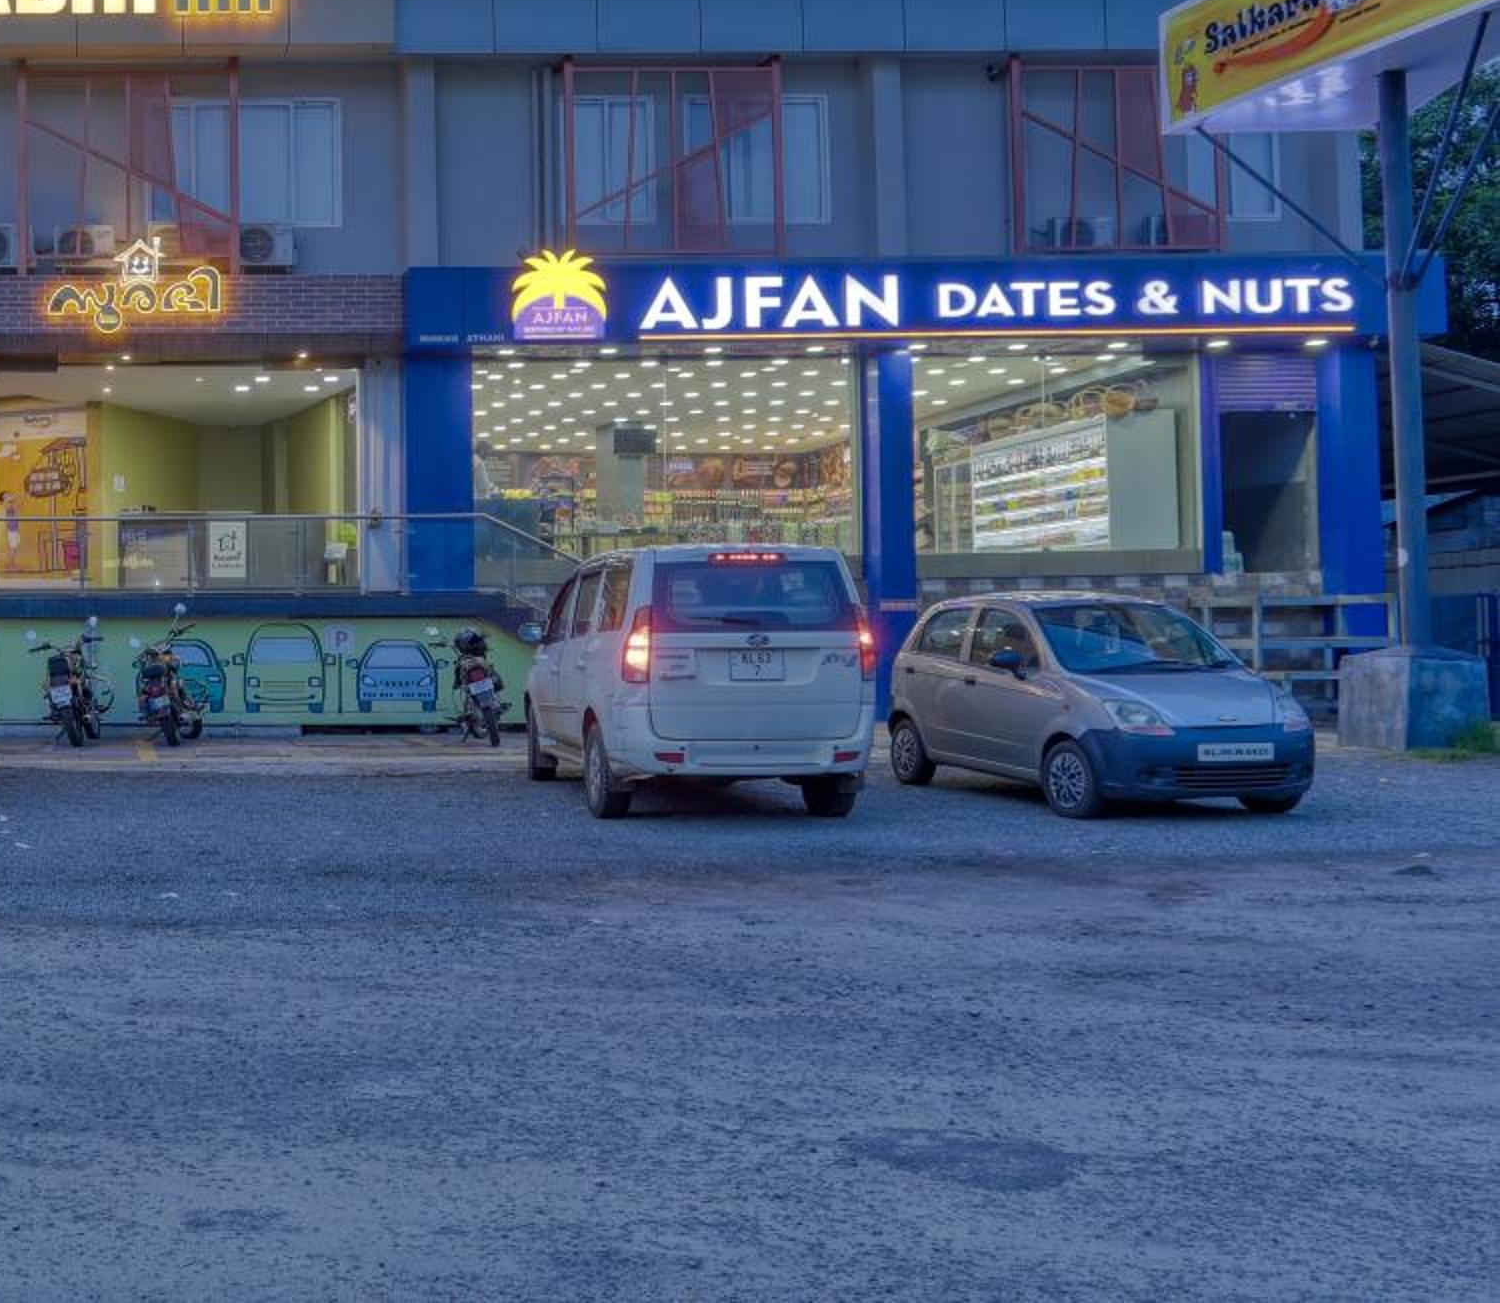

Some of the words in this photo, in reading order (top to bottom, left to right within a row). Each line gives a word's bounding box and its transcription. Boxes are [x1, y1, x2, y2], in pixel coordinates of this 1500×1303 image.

[639, 275, 899, 329] AJFAN
[937, 282, 1116, 317] DATES
[1137, 280, 1179, 315] &
[1202, 278, 1354, 314] NUTS
[533, 312, 587, 324] AJFAN
[336, 631, 348, 646] P
